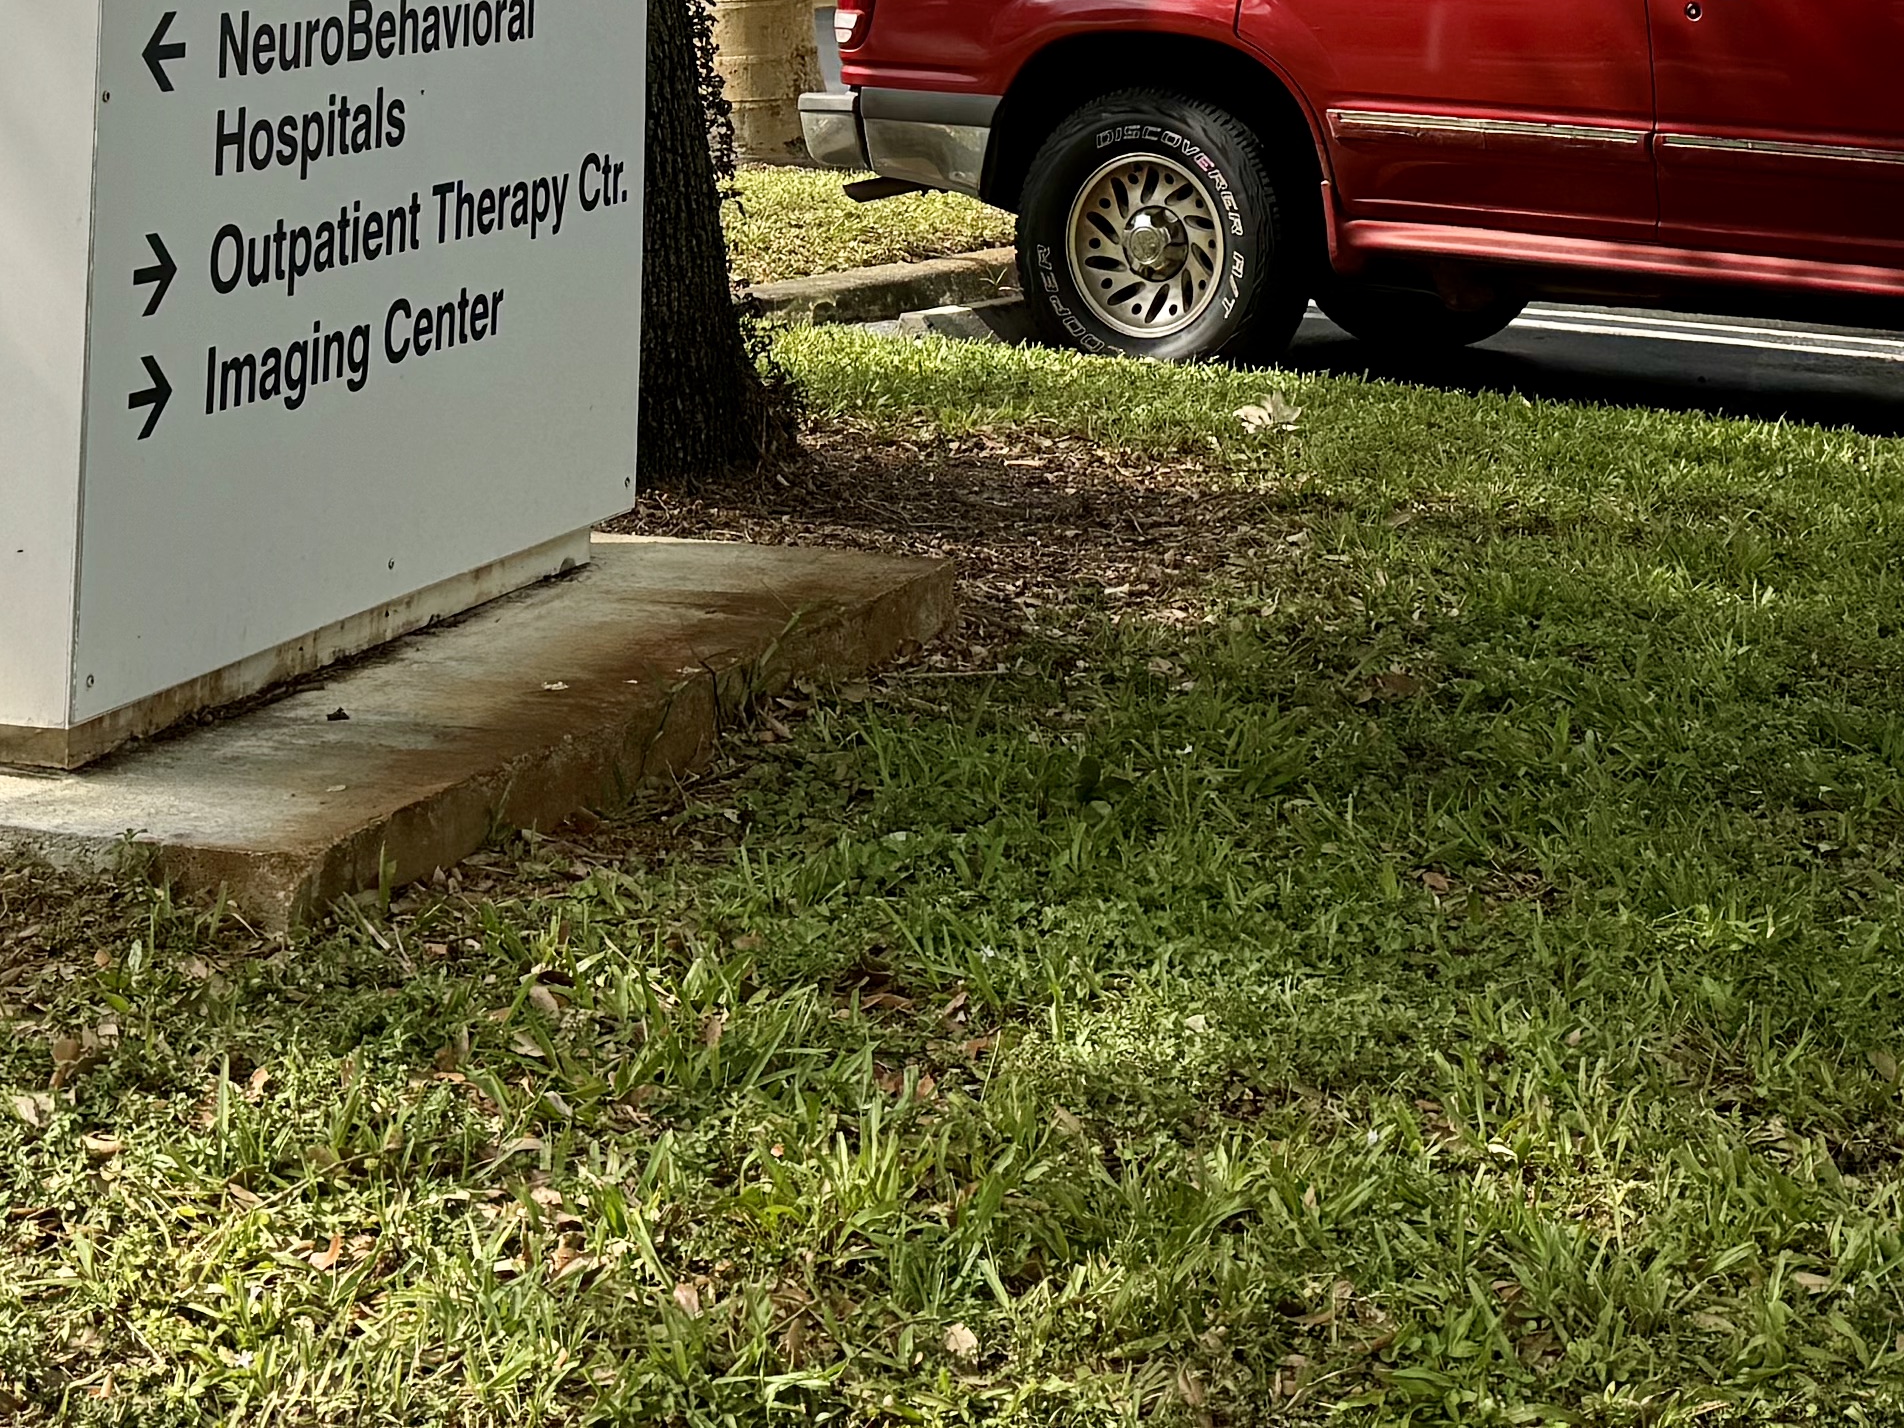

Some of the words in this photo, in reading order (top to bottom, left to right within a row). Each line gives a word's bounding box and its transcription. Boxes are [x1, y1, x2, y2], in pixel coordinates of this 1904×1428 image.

[214, 86, 407, 179] Hospitals
[1096, 125, 1243, 236] DISCOVERER
[209, 193, 421, 296] Outpatient
[432, 167, 570, 244] Therapy
[578, 153, 629, 213] Ctr.
[204, 321, 371, 415] Imaging
[384, 288, 505, 365] Center
[1037, 244, 1105, 353] OOPER
